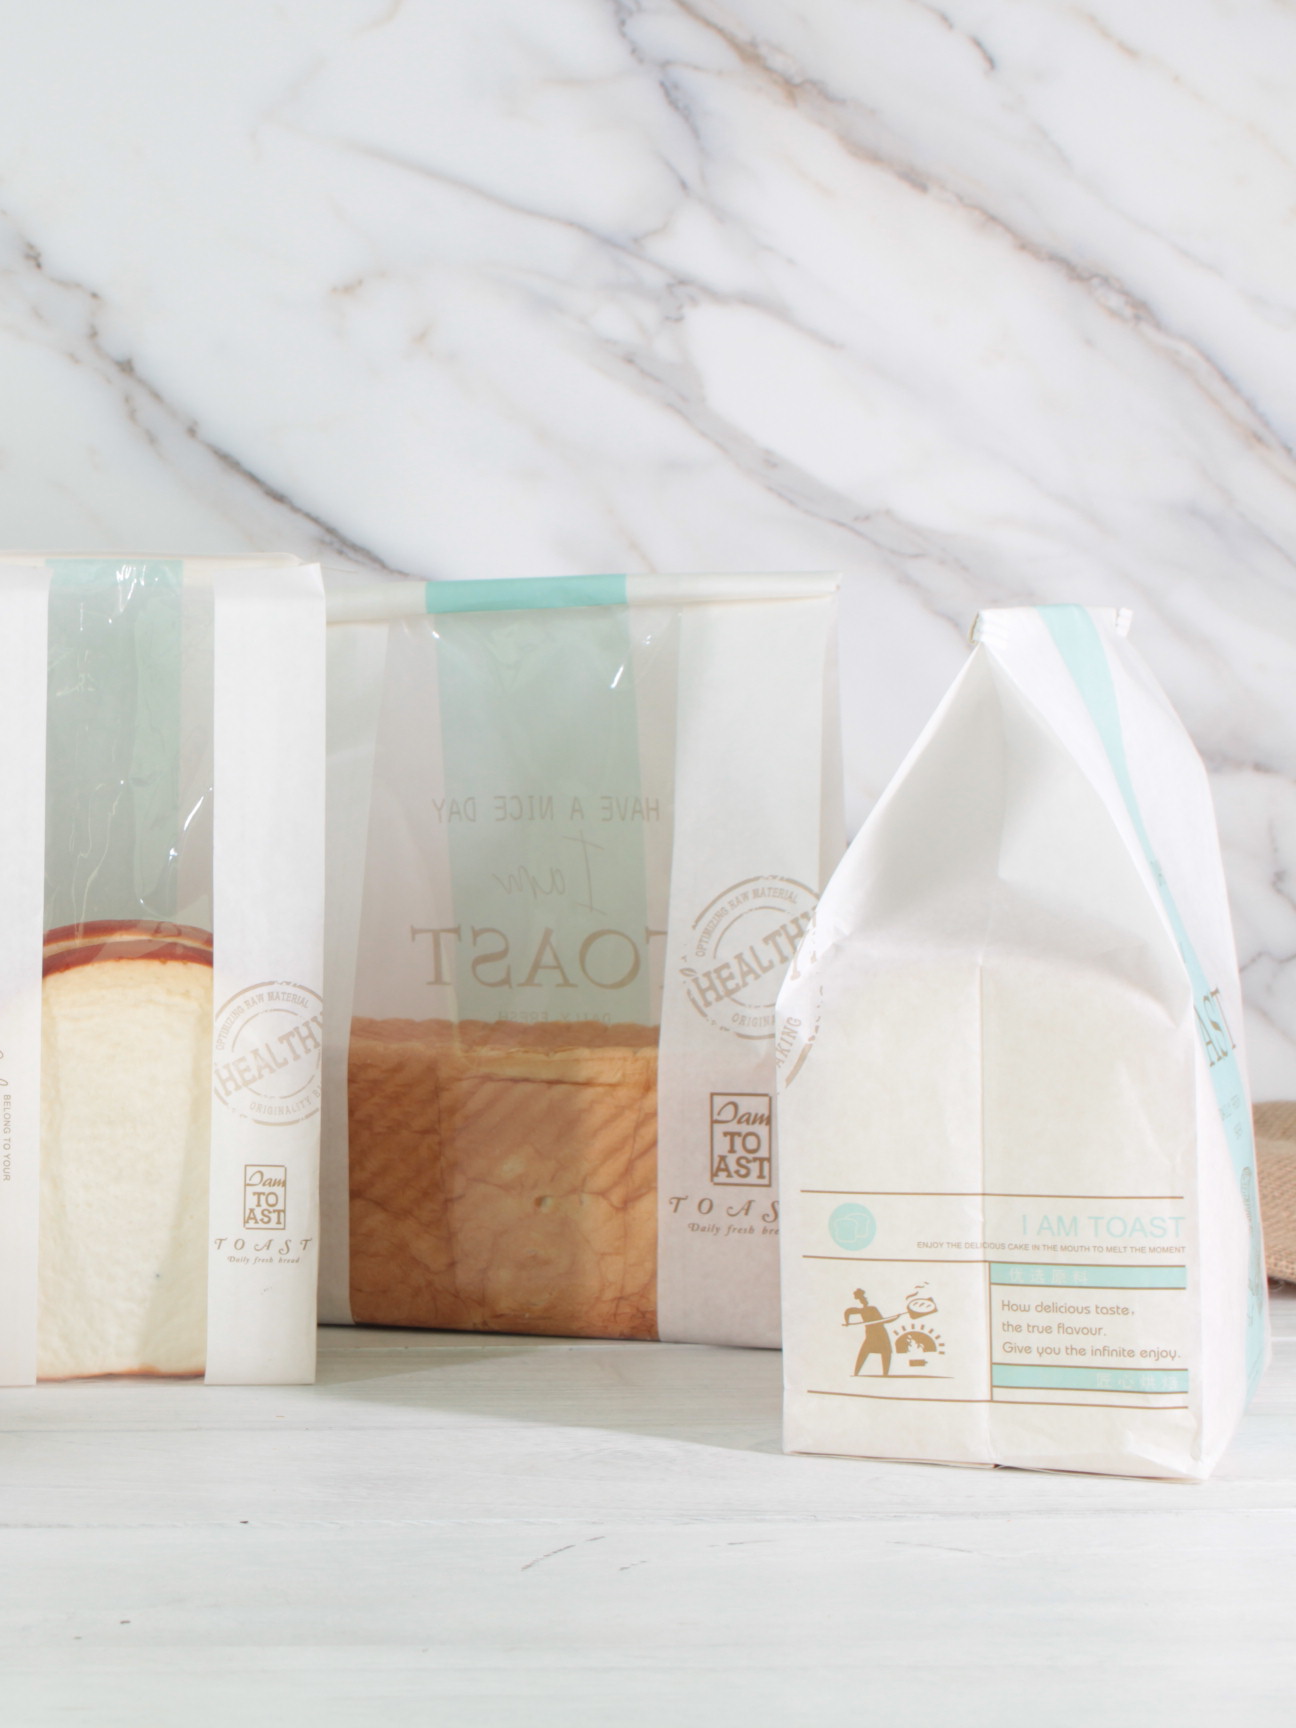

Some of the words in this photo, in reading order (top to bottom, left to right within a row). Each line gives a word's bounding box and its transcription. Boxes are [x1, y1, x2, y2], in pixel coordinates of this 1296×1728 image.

[695, 907, 729, 957] OPTIMIZING
[728, 891, 750, 908] RAW
[752, 887, 798, 905] MATERIAL
[692, 911, 811, 1008] HEALTH
[216, 1005, 245, 1050] OPTIMIZING
[244, 992, 265, 1010] RAW
[267, 991, 310, 1009] MATERIAL
[3, 1094, 11, 1134] BELONG
[250, 1096, 312, 1116] ORIGINALITY
[3, 1136, 11, 1151] TO
[722, 1131, 761, 1154] TO
[3, 1153, 11, 1182] YOUR
[712, 1154, 770, 1179] AST
[252, 1191, 279, 1208] TO
[245, 1208, 285, 1225] AST
[1021, 1214, 1028, 1236] I
[1037, 1214, 1079, 1237] AM
[1087, 1215, 1186, 1238] TOAST
[688, 1222, 721, 1236] Daily
[724, 1224, 755, 1237] fresh
[214, 1237, 313, 1256] TOAST
[916, 1241, 944, 1249] ENJOY
[946, 1241, 962, 1249] THE
[964, 1242, 1006, 1250] DELICIOUS
[1008, 1243, 1030, 1251] CAKE
[1032, 1243, 1040, 1251] IN
[1042, 1244, 1057, 1252] THE
[1060, 1245, 1090, 1253] MOUTH
[1092, 1245, 1104, 1253] TO
[1106, 1245, 1128, 1254] MELT
[1130, 1246, 1147, 1254] THE
[1148, 1246, 1186, 1254] MOMENT
[227, 1256, 250, 1265] Daily
[253, 1256, 274, 1265] fresh
[278, 1256, 301, 1264] bread
[1002, 1300, 1031, 1313] How
[1035, 1301, 1091, 1315] delicious
[1002, 1321, 1022, 1333] the
[1026, 1322, 1053, 1335] true
[1057, 1322, 1106, 1337] flavour.
[1002, 1341, 1032, 1354] Give
[1036, 1346, 1061, 1358] you
[1065, 1344, 1087, 1356] the
[1091, 1345, 1135, 1359] infinite
[1140, 1348, 1181, 1362] enjoy.
